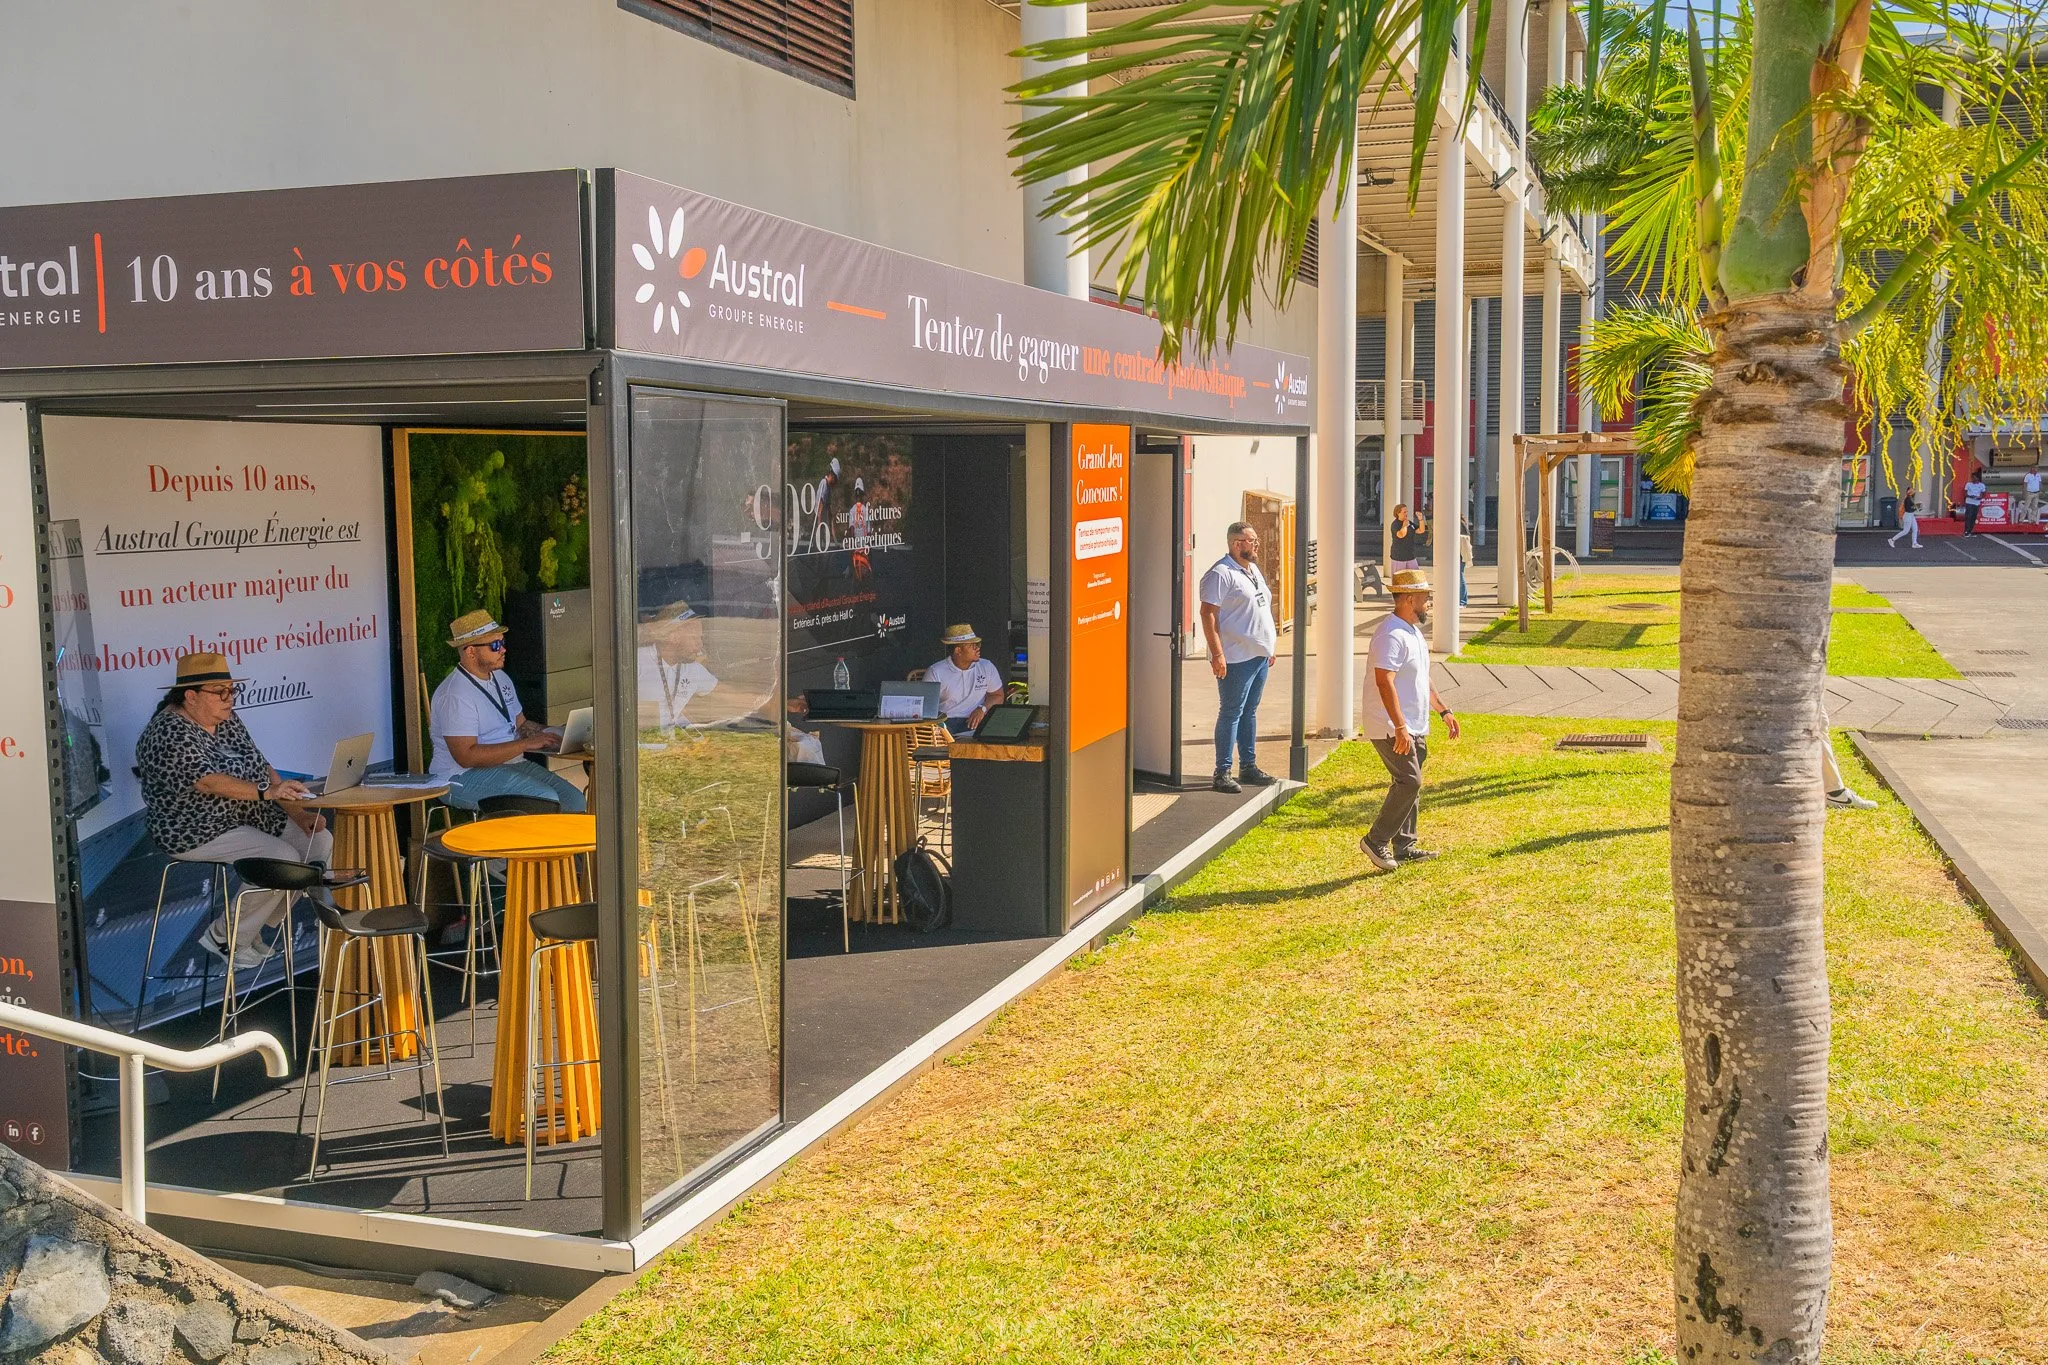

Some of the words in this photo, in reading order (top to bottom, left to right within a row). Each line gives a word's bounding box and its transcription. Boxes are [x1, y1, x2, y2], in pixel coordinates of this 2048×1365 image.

[0, 246, 79, 297] tral
[126, 254, 179, 303] 10
[195, 266, 273, 300] ans
[289, 247, 315, 296] à
[329, 256, 407, 294] vos
[425, 234, 553, 291] côtés
[709, 244, 805, 308] Austral
[709, 304, 754, 326] GROUPE
[759, 313, 804, 334] ENERGIE
[907, 294, 984, 358] Tentez
[990, 313, 1013, 362] de
[1018, 335, 1079, 385] gagner
[1083, 346, 1111, 377] une
[1288, 373, 1307, 395] Austral
[1078, 444, 1106, 470] Grand
[1108, 444, 1122, 468] Jeu
[147, 464, 234, 501] Depuis
[241, 464, 267, 492] 10
[274, 469, 316, 496] ans,
[1076, 479, 1118, 506] Concours
[835, 512, 850, 524] sur
[865, 501, 901, 523] factures
[95, 521, 180, 552] Austral
[186, 521, 259, 553] Groupe
[263, 511, 335, 549] Énergie
[338, 518, 361, 540] est
[842, 530, 901, 556] énergétiques
[119, 584, 153, 607] un
[162, 580, 237, 605] acteur
[244, 568, 319, 604] majeur
[325, 565, 350, 590] du
[275, 614, 379, 651] résidentiel
[793, 615, 815, 630] Extérieur
[840, 610, 848, 621] Hall
[849, 609, 854, 619] C
[888, 614, 906, 627] Austral
[233, 676, 312, 706] Réunion.
